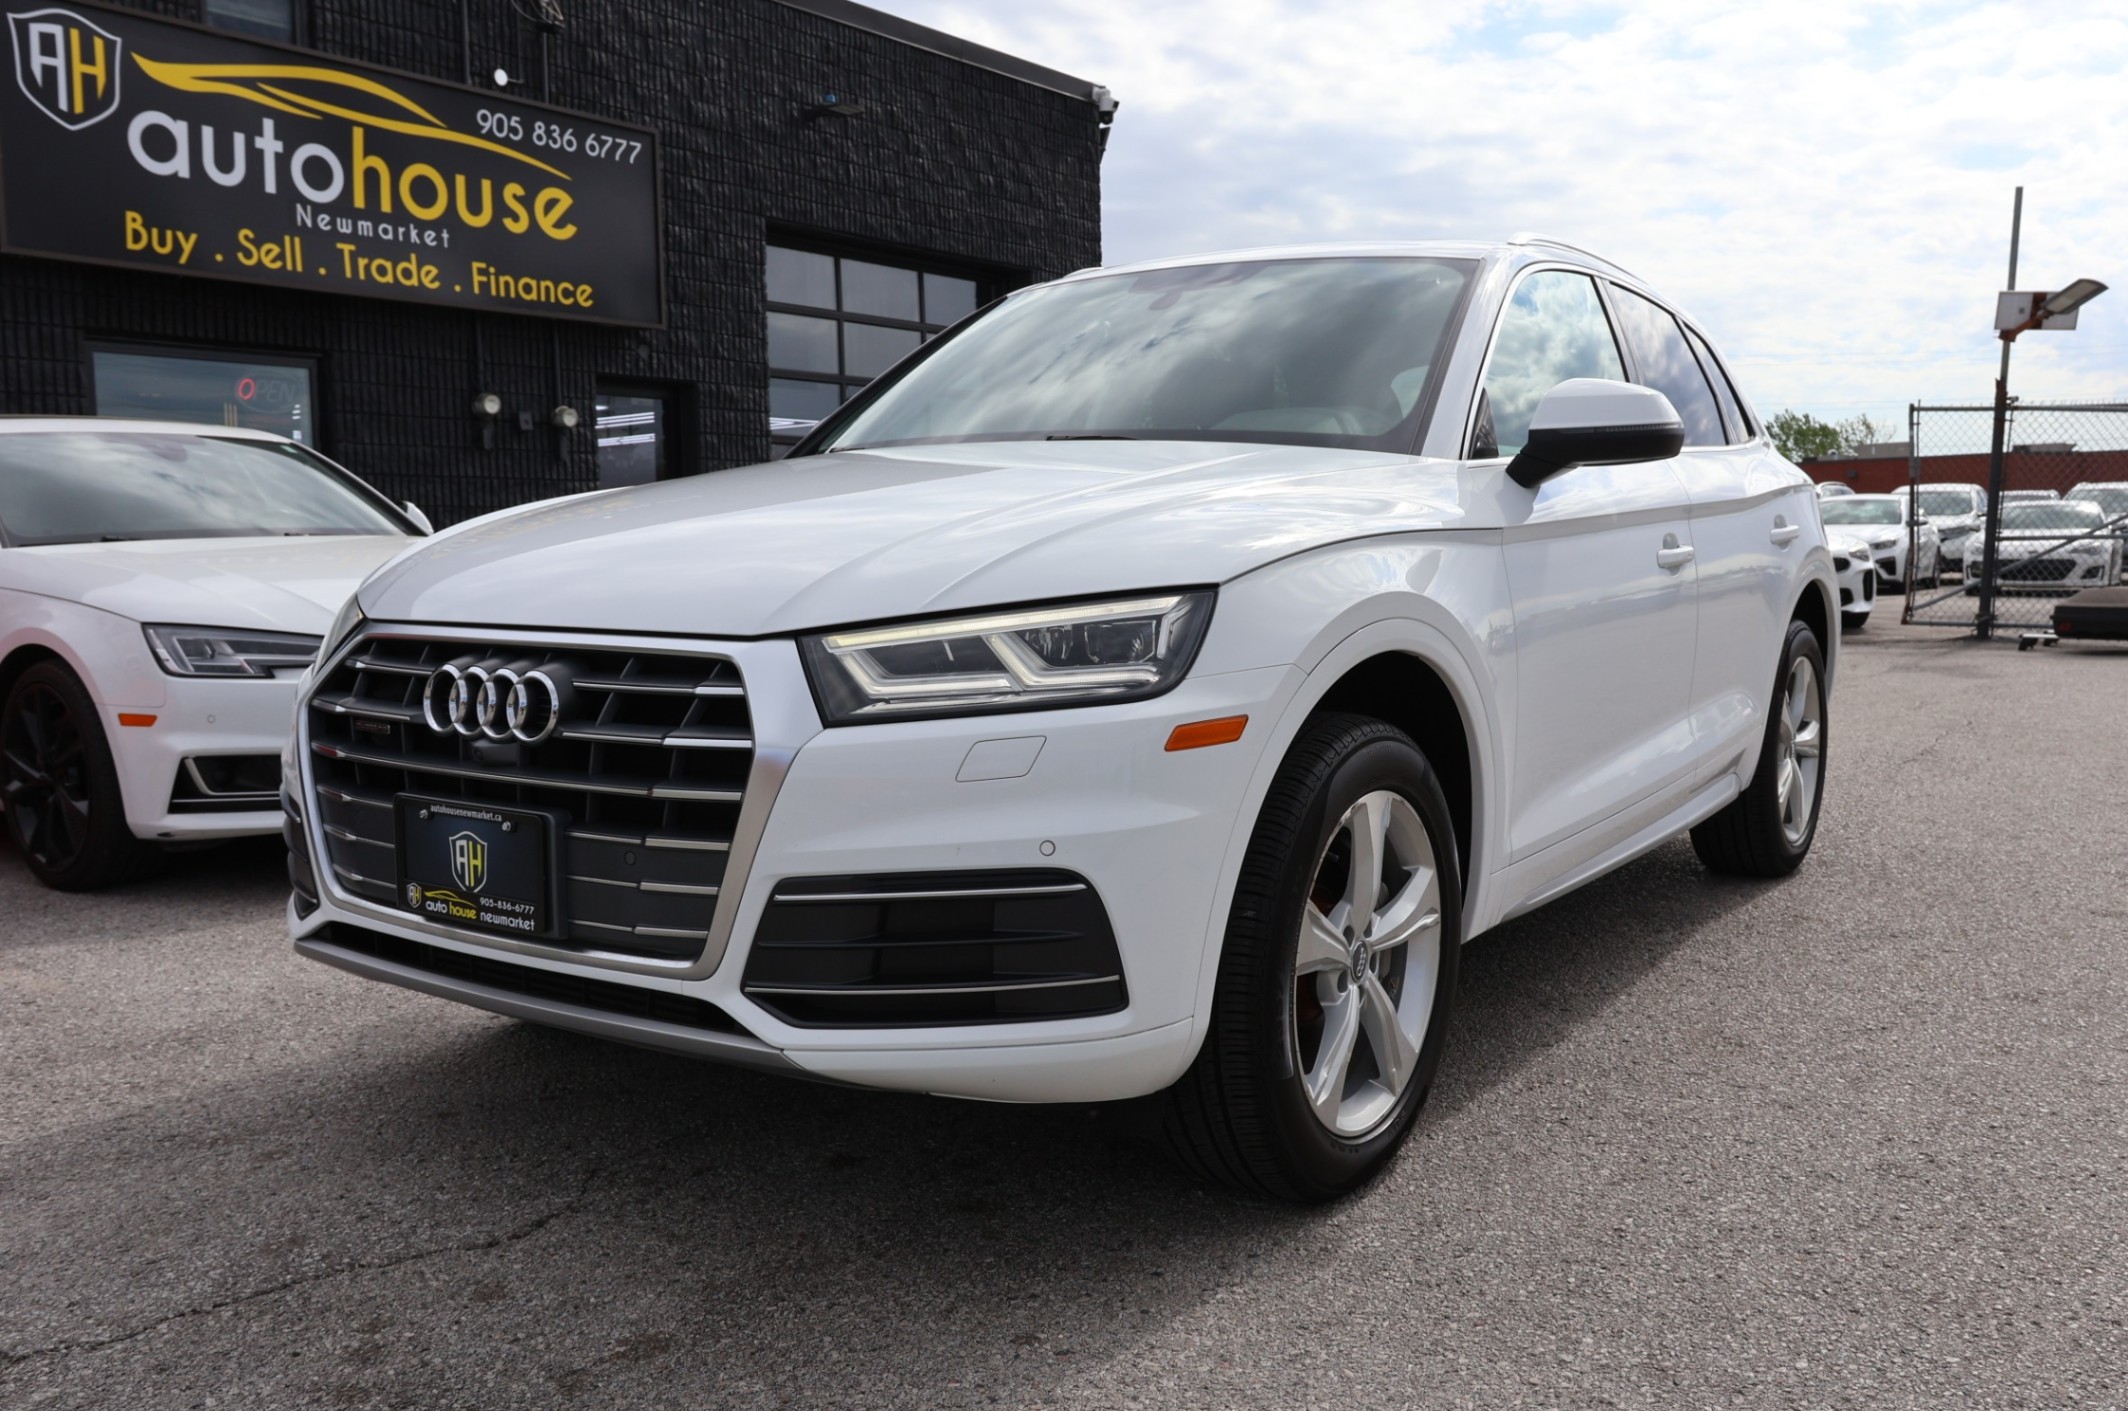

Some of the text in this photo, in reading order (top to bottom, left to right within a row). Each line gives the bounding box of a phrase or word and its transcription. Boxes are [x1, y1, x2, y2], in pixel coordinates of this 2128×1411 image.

[29, 22, 107, 114] AH
[476, 109, 642, 164] 905 836 6777
[296, 203, 450, 248] Newmarket
[125, 210, 198, 264] Buy
[237, 228, 303, 272] Sell
[335, 242, 441, 289] Trade
[471, 261, 594, 307] Finance
[430, 804, 502, 822] autohousenewmarket.ca
[425, 900, 477, 919] auto house
[480, 897, 535, 914] 905-836-6777
[480, 912, 535, 931] newmarket
